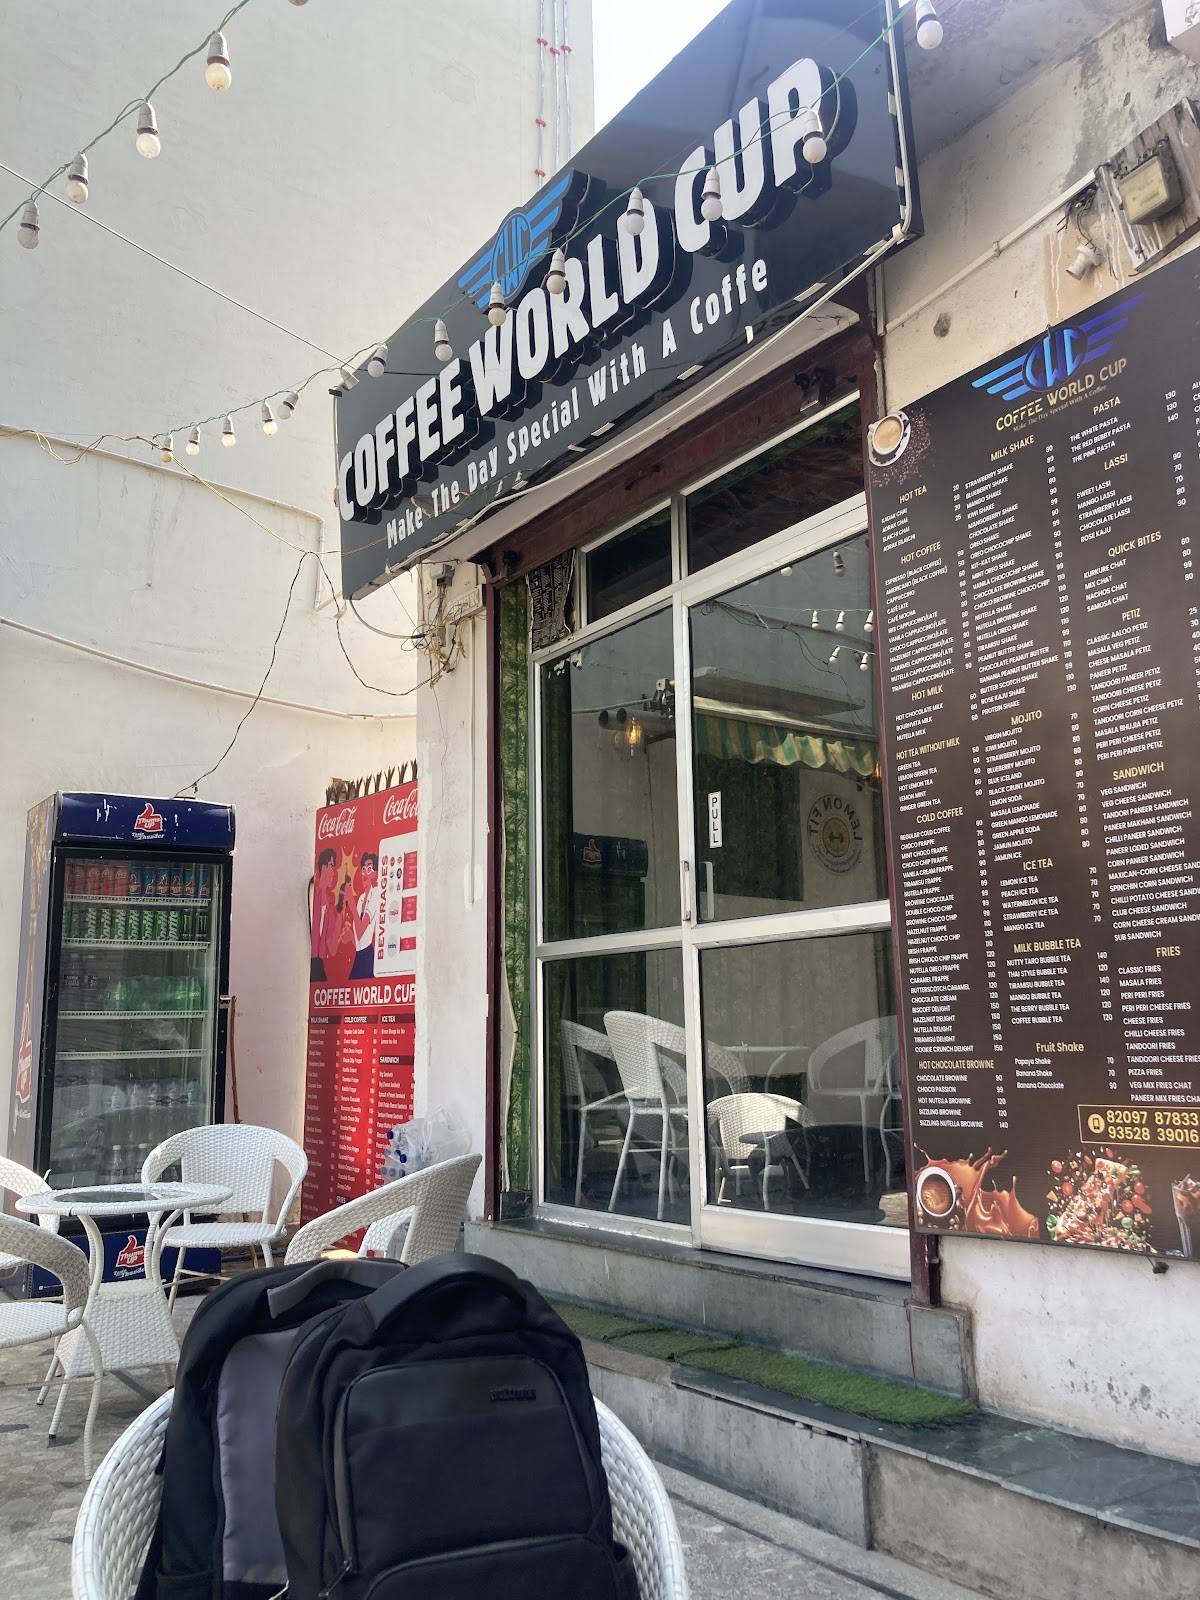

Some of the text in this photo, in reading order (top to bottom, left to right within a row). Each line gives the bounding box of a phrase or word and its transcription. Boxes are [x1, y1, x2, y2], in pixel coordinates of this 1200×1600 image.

[337, 57, 824, 522] COFFEE WORLD CUP
[996, 358, 1126, 430] COFFEE WORLD CUP
[1165, 390, 1176, 399] 130
[386, 259, 768, 549] Make The Day Special With A Coffe
[1093, 396, 1120, 414] PASTA
[1166, 401, 1177, 410] 130
[1167, 412, 1178, 422] 140
[1070, 416, 1118, 441] THE WHITE PASTA
[1071, 443, 1081, 452] THE
[1082, 438, 1093, 447] RED
[1111, 422, 1131, 434] PASTA
[990, 434, 1034, 461] MILK SHAKE
[1072, 440, 1115, 462] THE PINK PASTA
[1104, 453, 1128, 470] LASSI
[899, 485, 927, 503] HOT TEA
[1076, 480, 1111, 498] SWEET LASSI
[1077, 490, 1115, 509] MANGO LASSI
[1078, 495, 1132, 520] STRAWBERRY LASSI
[1080, 526, 1111, 542] ROSE KAJU
[1108, 531, 1161, 556] QUICK BITES
[900, 541, 940, 564] HOT COFFEE
[1110, 558, 1126, 569] CHAT
[1084, 575, 1112, 589] MIX CHAT
[1086, 582, 1127, 600] NACHOS CHAT
[1087, 593, 1128, 611] SAMOSA CHAT
[1086, 633, 1110, 645] CLASSIC
[1089, 668, 1111, 679] PANEER
[911, 684, 943, 700] HOT MILK
[1011, 710, 1042, 724] MOJITO
[984, 727, 1022, 740] VIRGIN MOJITO
[896, 737, 960, 759] HOT TEA WITHOUT MILK
[1113, 762, 1164, 780] SANDWICH
[1113, 781, 1146, 793] SANDWICH
[1114, 795, 1136, 805] CHEESE
[1137, 789, 1171, 800] SANDWICH
[318, 806, 357, 840] Coca-Cola
[916, 806, 963, 823] COLD COFFEE
[1023, 858, 1053, 870] ICE TEA
[377, 855, 389, 960] BEVERAGES
[1013, 938, 1081, 952] MILK BUBBLE TEA
[1156, 946, 1180, 956] FRIES
[1118, 966, 1143, 974] CLASSIC
[314, 988, 351, 1006] COFFEE
[354, 985, 392, 1004] WORLD
[1036, 1042, 1084, 1052] Fruit Shake
[918, 1060, 930, 1069] HOT
[931, 1060, 965, 1068] CHOCOLATE
[1106, 1110, 1198, 1125] 82097 87833
[1108, 1124, 1199, 1142] 93528 39016
